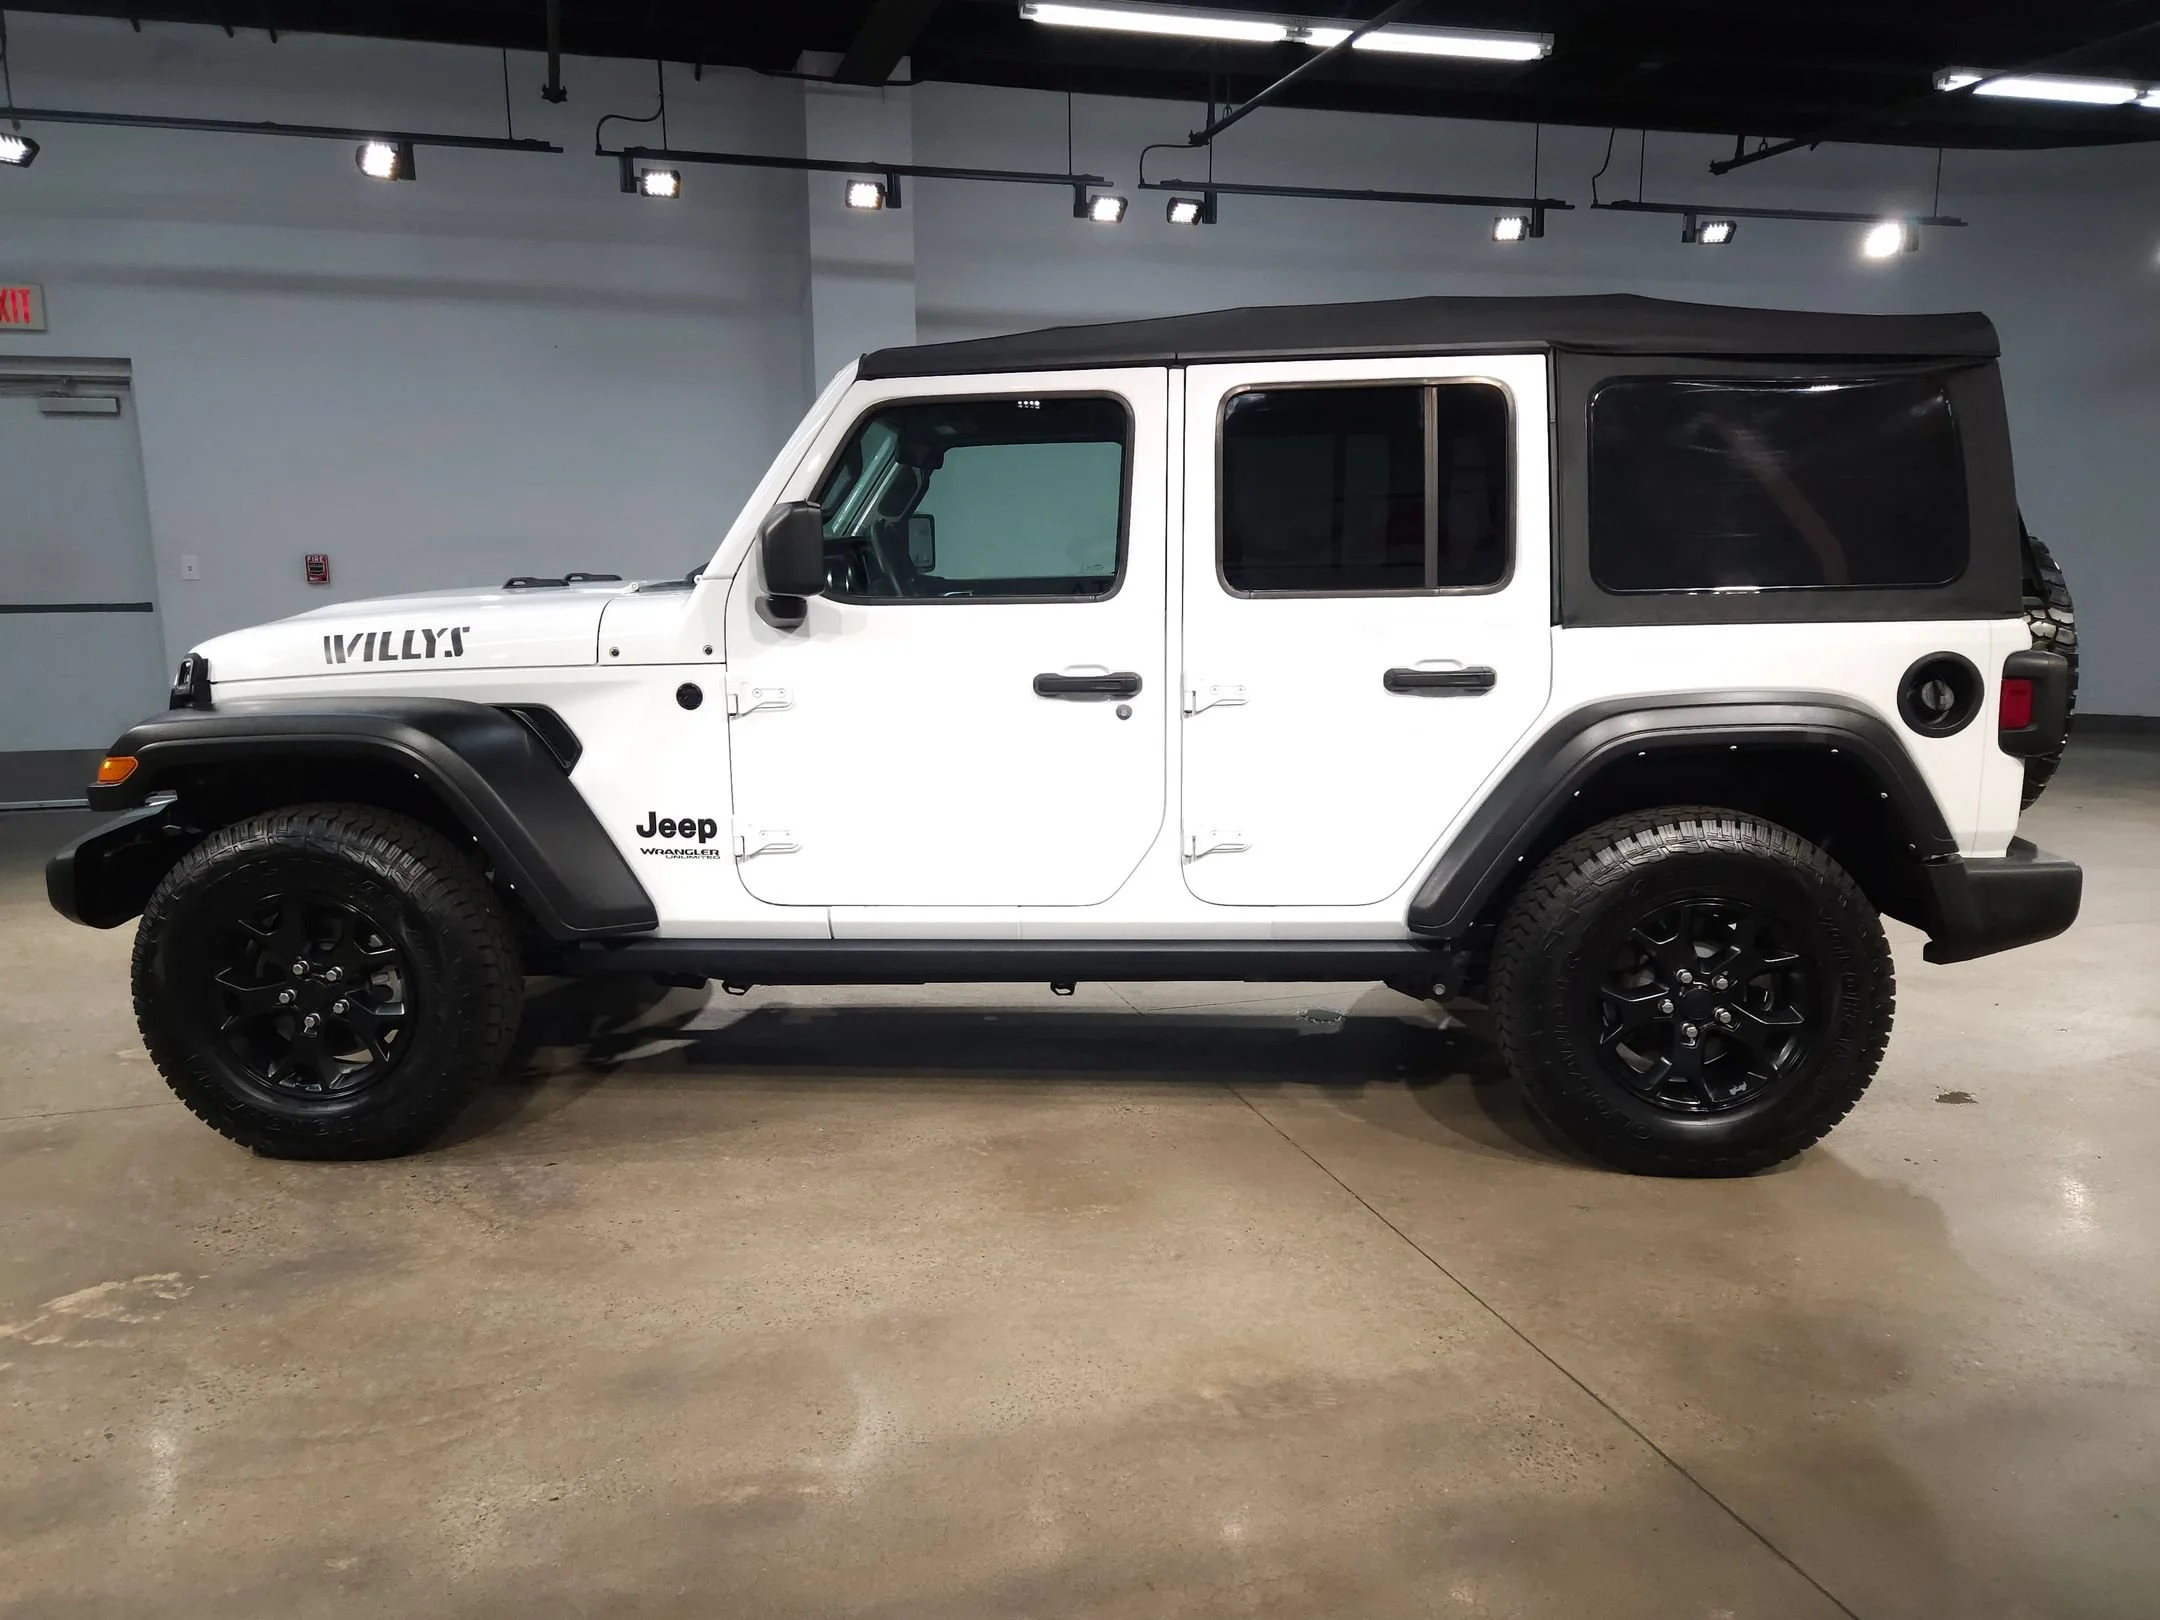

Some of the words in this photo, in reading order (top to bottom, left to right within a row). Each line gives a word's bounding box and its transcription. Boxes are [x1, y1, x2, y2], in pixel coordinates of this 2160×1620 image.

[323, 626, 471, 665] WILLYS
[636, 811, 718, 844] Jeep
[640, 847, 720, 856] WRANGLER
